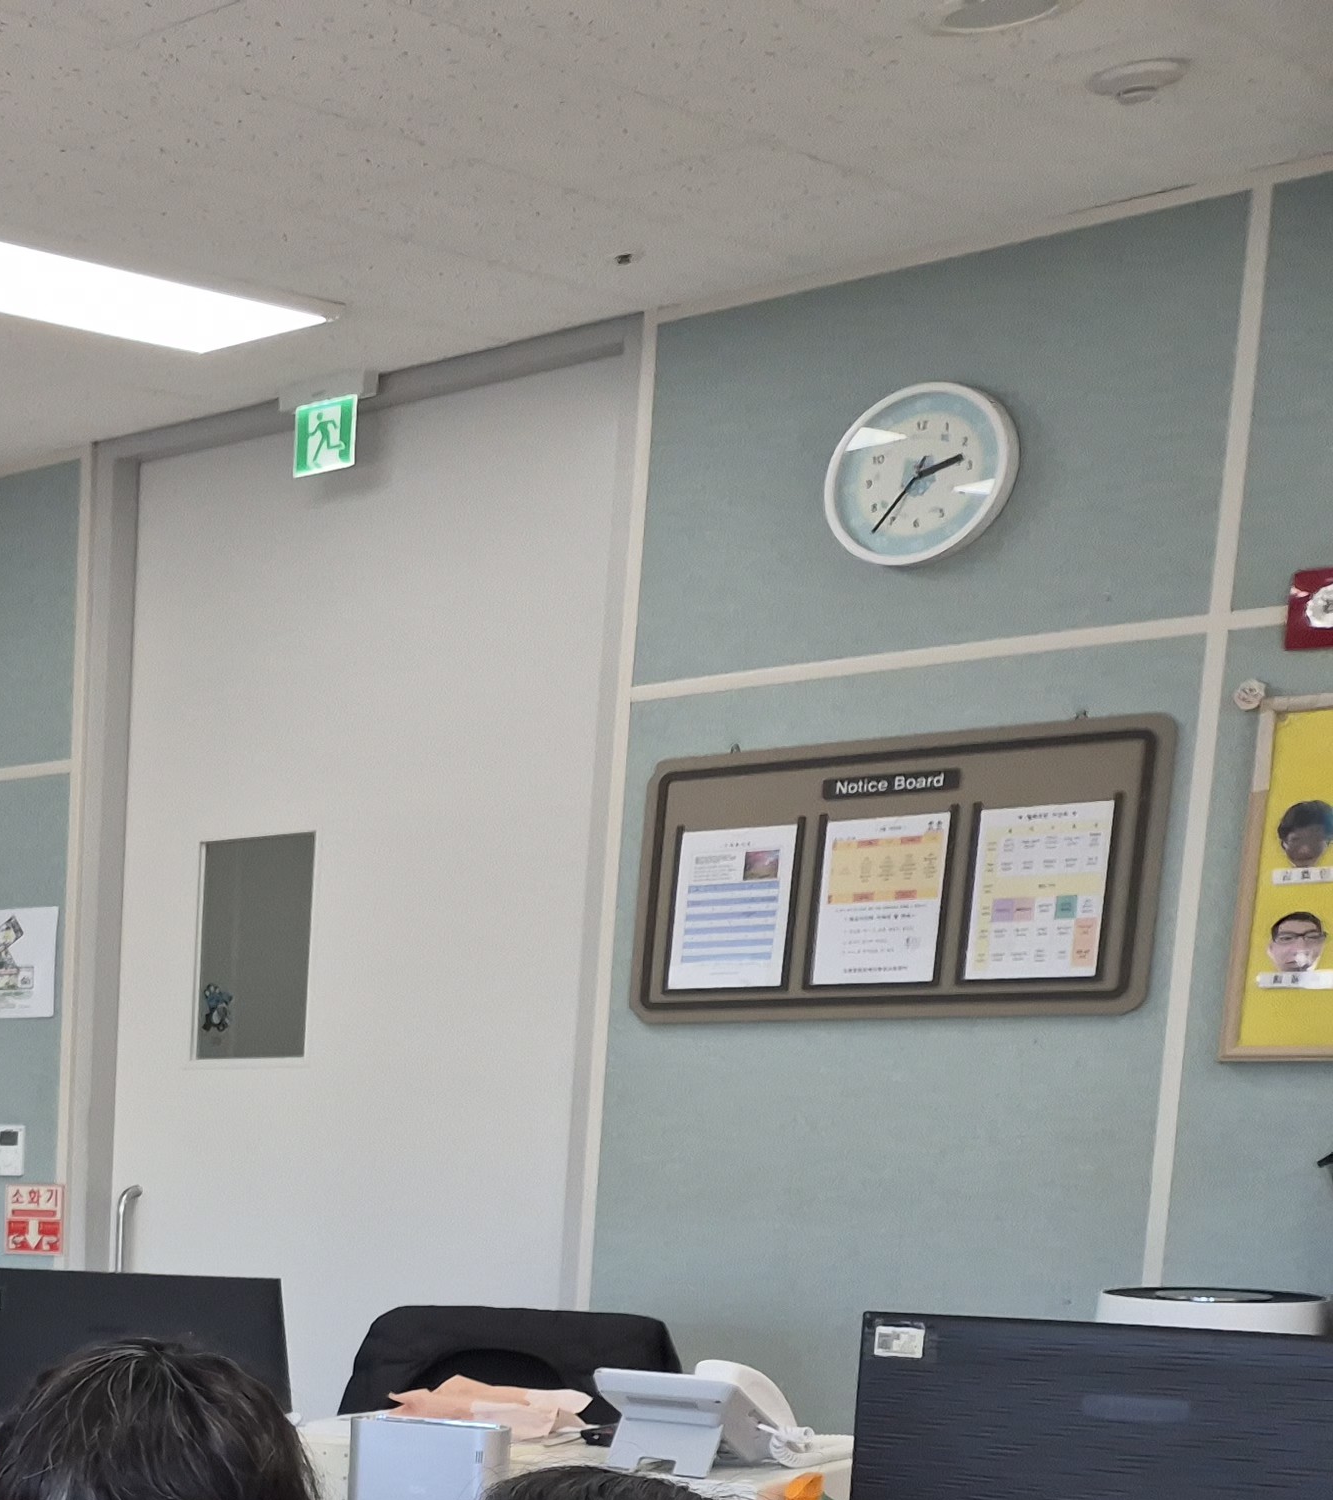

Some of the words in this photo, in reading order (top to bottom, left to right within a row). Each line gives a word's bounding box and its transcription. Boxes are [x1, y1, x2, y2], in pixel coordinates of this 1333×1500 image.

[835, 778, 889, 795] Notice
[894, 772, 945, 791] Board
[11, 1188, 58, 1208] 소화기
